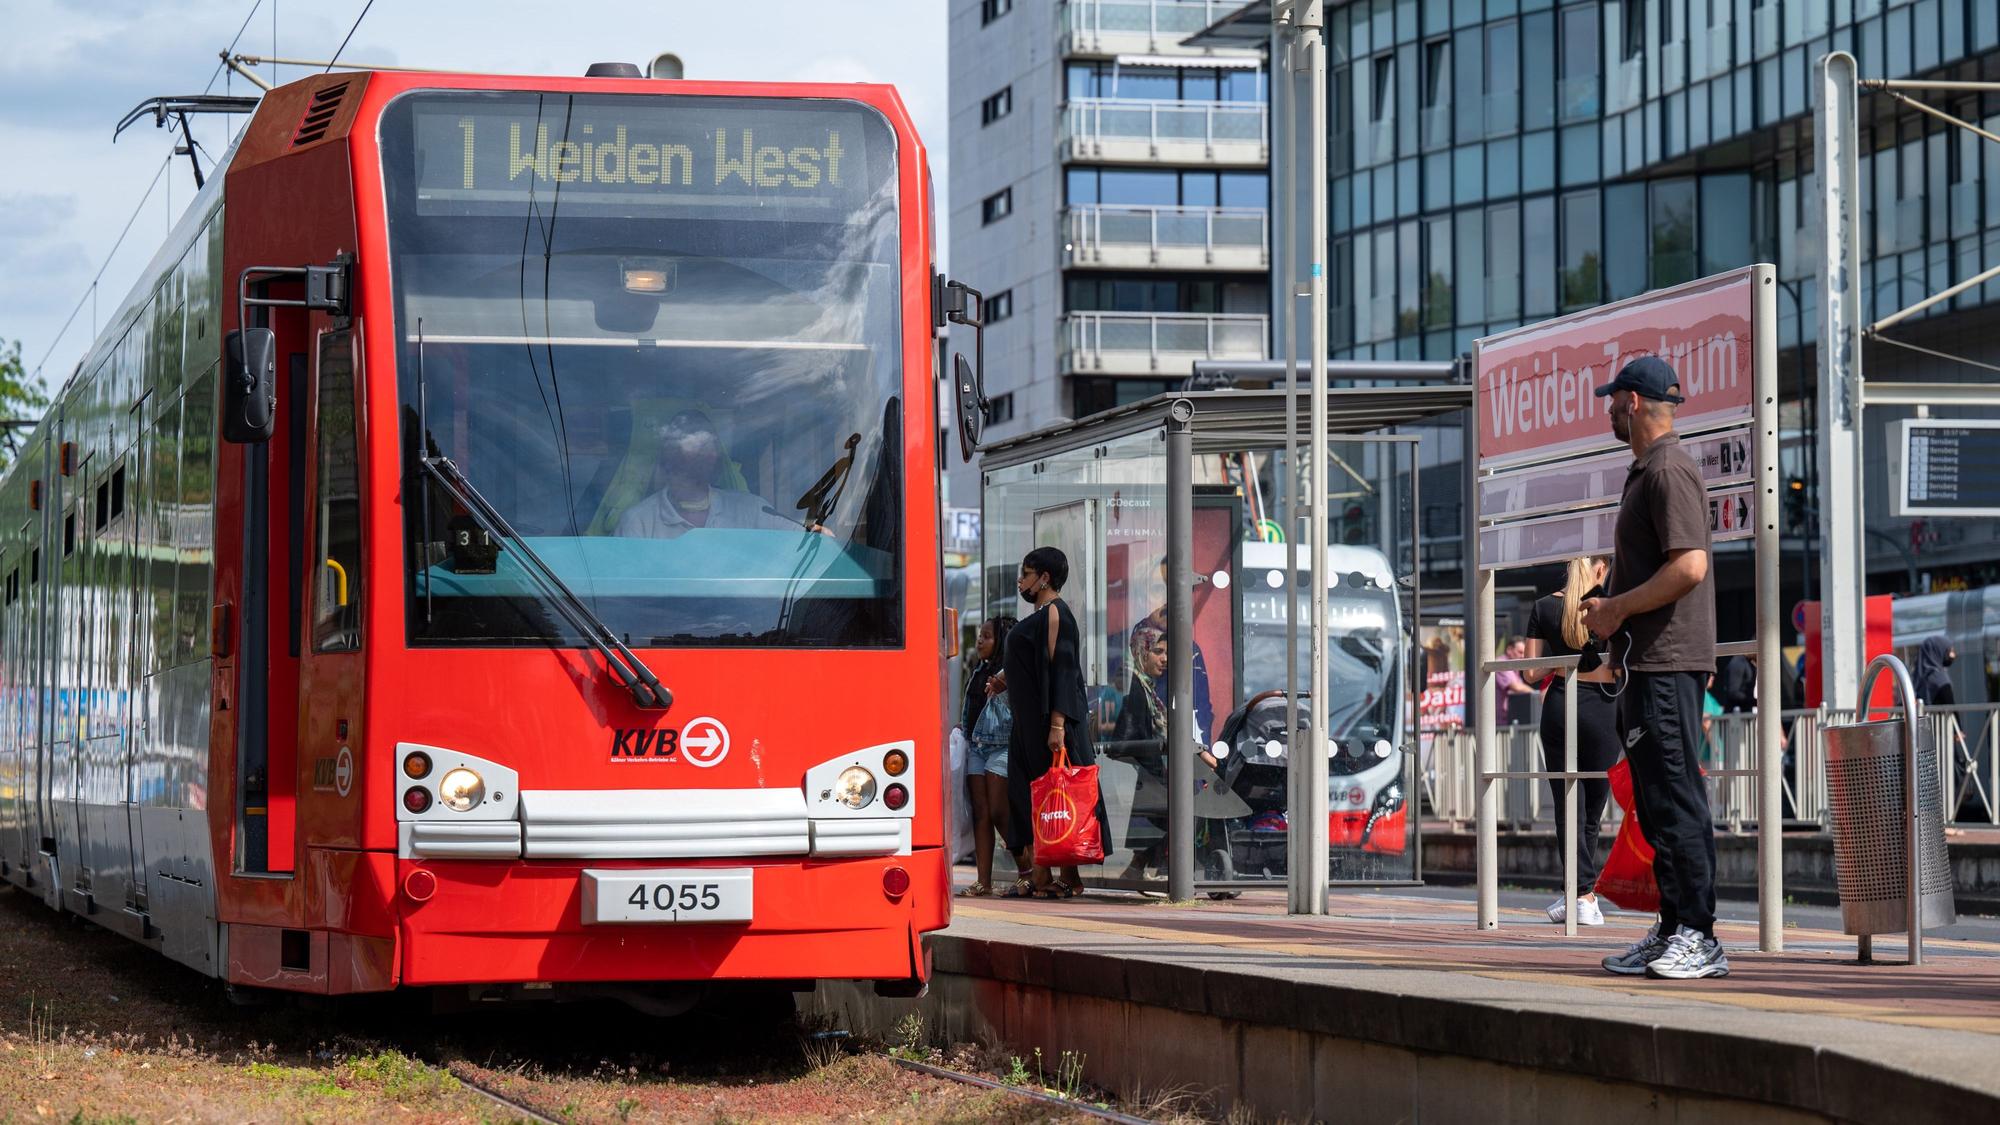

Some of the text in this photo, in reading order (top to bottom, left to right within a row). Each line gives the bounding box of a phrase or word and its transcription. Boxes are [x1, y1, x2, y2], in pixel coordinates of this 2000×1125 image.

[458, 117, 846, 189] 1 Weiden West
[1488, 330, 1737, 438] Weiden Ztrum
[1707, 454, 1719, 466] West
[611, 729, 678, 756] KVB
[314, 758, 337, 785] KVB
[628, 884, 720, 910] 4055
